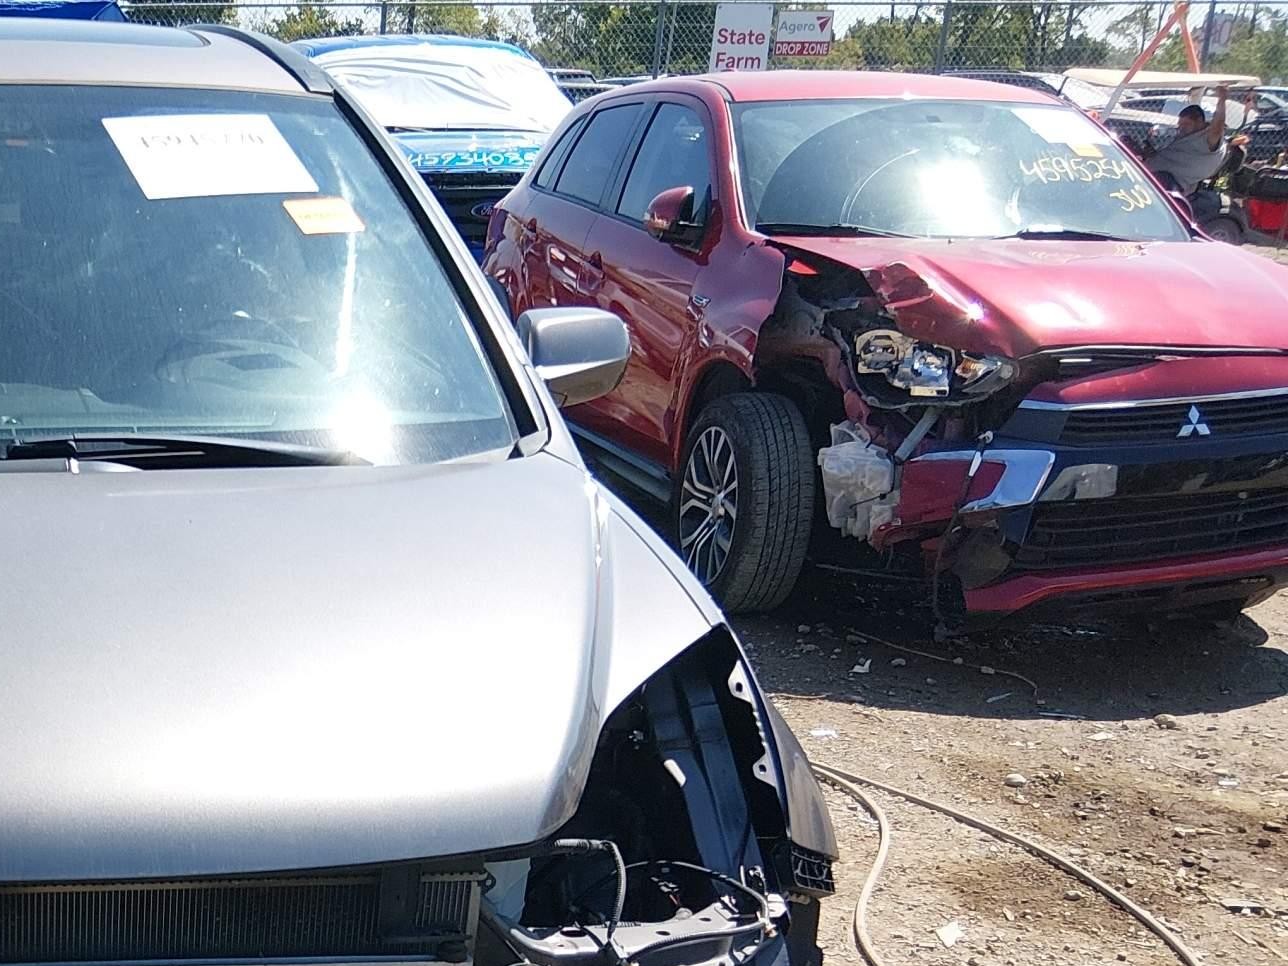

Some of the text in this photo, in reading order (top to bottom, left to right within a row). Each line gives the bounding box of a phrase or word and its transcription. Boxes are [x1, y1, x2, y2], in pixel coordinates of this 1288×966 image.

[779, 21, 815, 34] Agero
[717, 28, 766, 46] State
[775, 43, 829, 55] DROP ZONE
[715, 53, 762, 70] Farm
